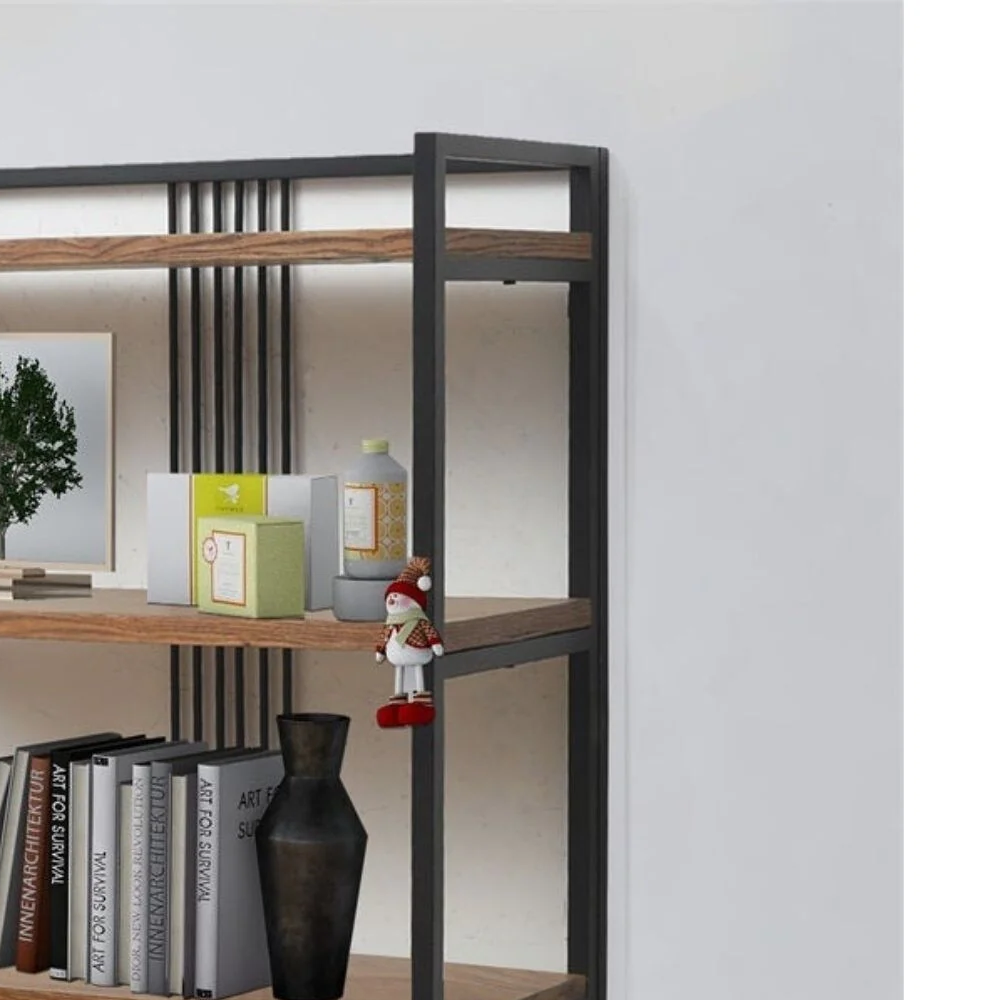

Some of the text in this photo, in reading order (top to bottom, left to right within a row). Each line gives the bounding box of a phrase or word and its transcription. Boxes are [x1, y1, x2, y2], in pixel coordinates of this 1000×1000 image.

[18, 769, 44, 942] INNENARCHITEKTUR
[51, 763, 67, 884] ART FOR SURVIVAL
[198, 778, 213, 902] ART FOR SURVIVAL
[237, 788, 263, 810] ART
[92, 851, 107, 973] ART FOR SURVIVAL
[148, 776, 166, 962] INNENARCHITEKTUR
